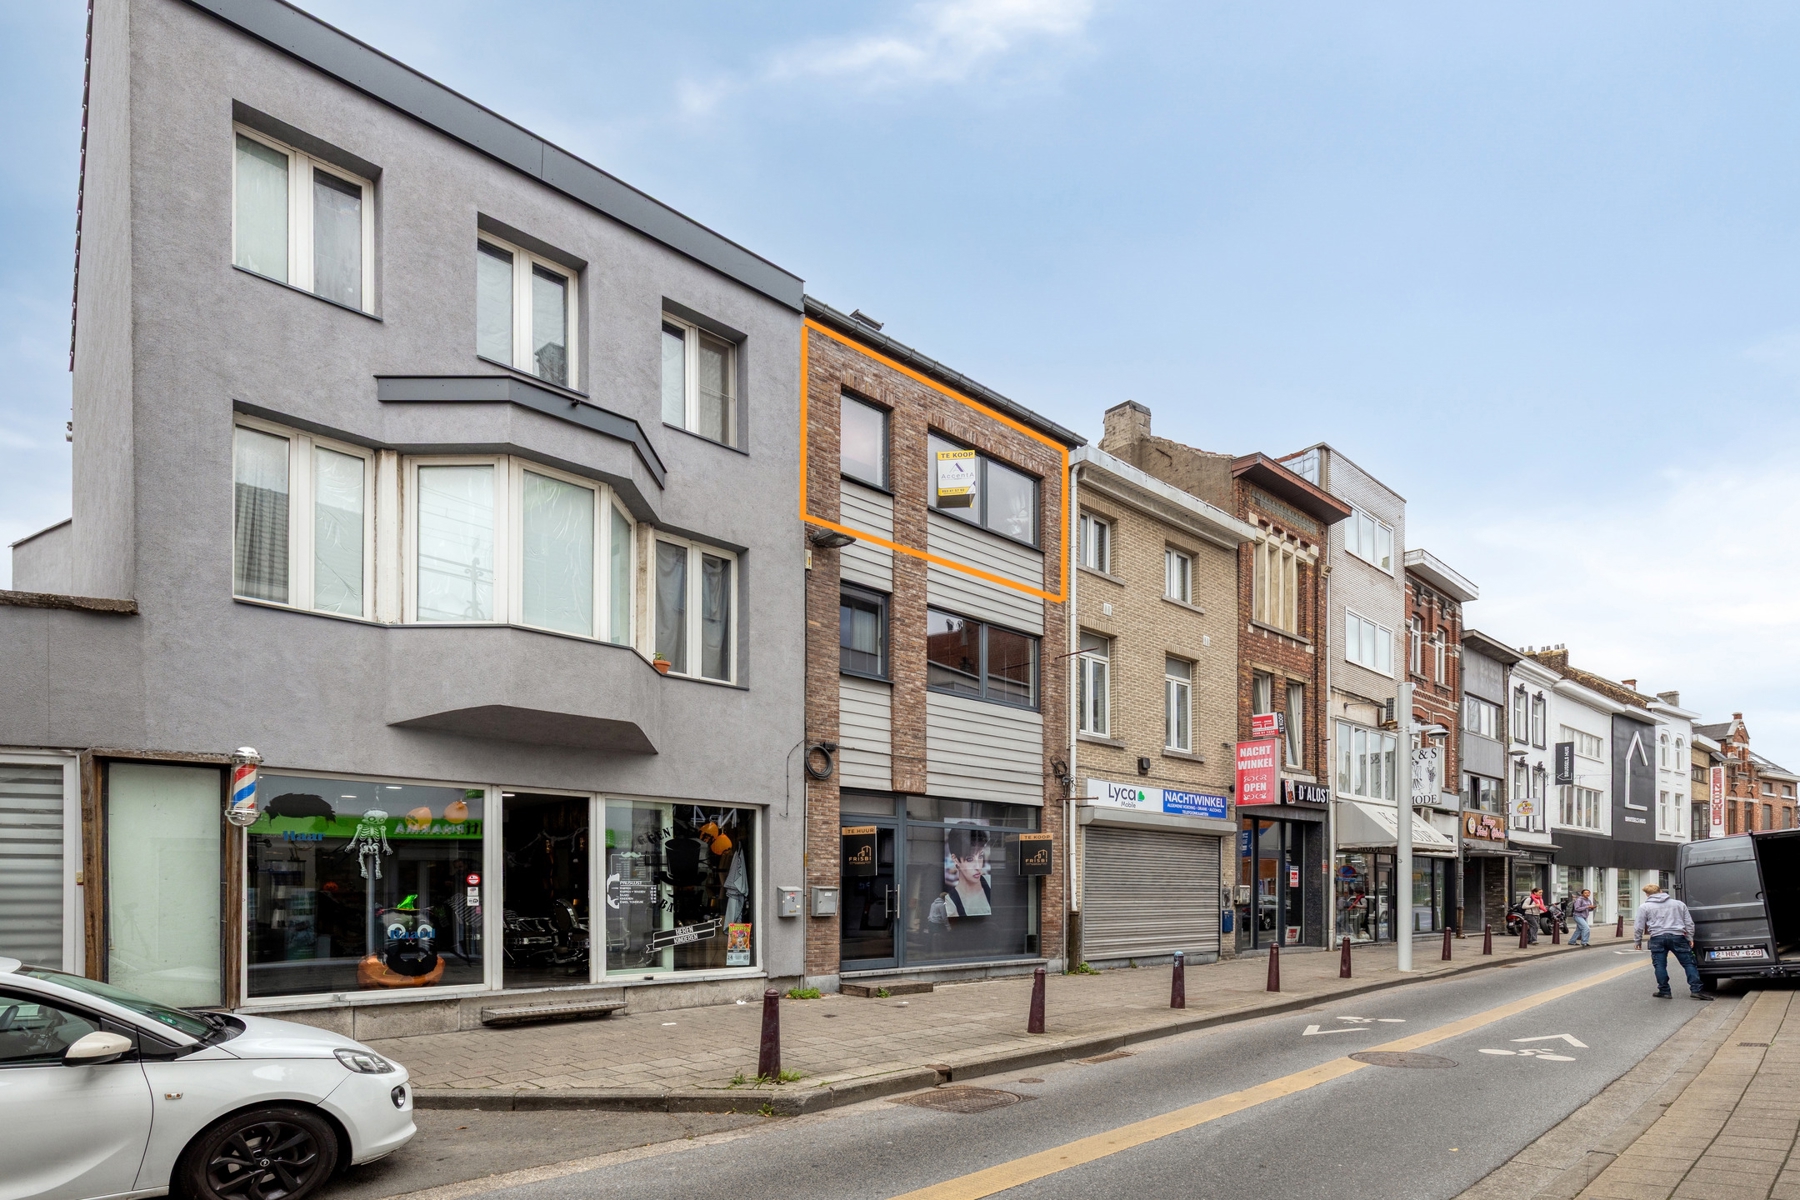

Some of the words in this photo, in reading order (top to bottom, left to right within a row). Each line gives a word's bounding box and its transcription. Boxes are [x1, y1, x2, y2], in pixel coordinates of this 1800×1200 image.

[1240, 745, 1271, 757] NACHT
[1238, 757, 1273, 770] WINKEL
[1108, 783, 1136, 801] Lyca
[1243, 782, 1267, 793] OPEN
[1164, 790, 1225, 808] NACHTWINKEL
[1298, 784, 1330, 804] D'ALOST
[1120, 800, 1136, 808] Mobile
[283, 831, 326, 841] Haar
[390, 928, 436, 940] Baard
[675, 925, 694, 936] HEREN
[674, 933, 699, 945] KINDEREN
